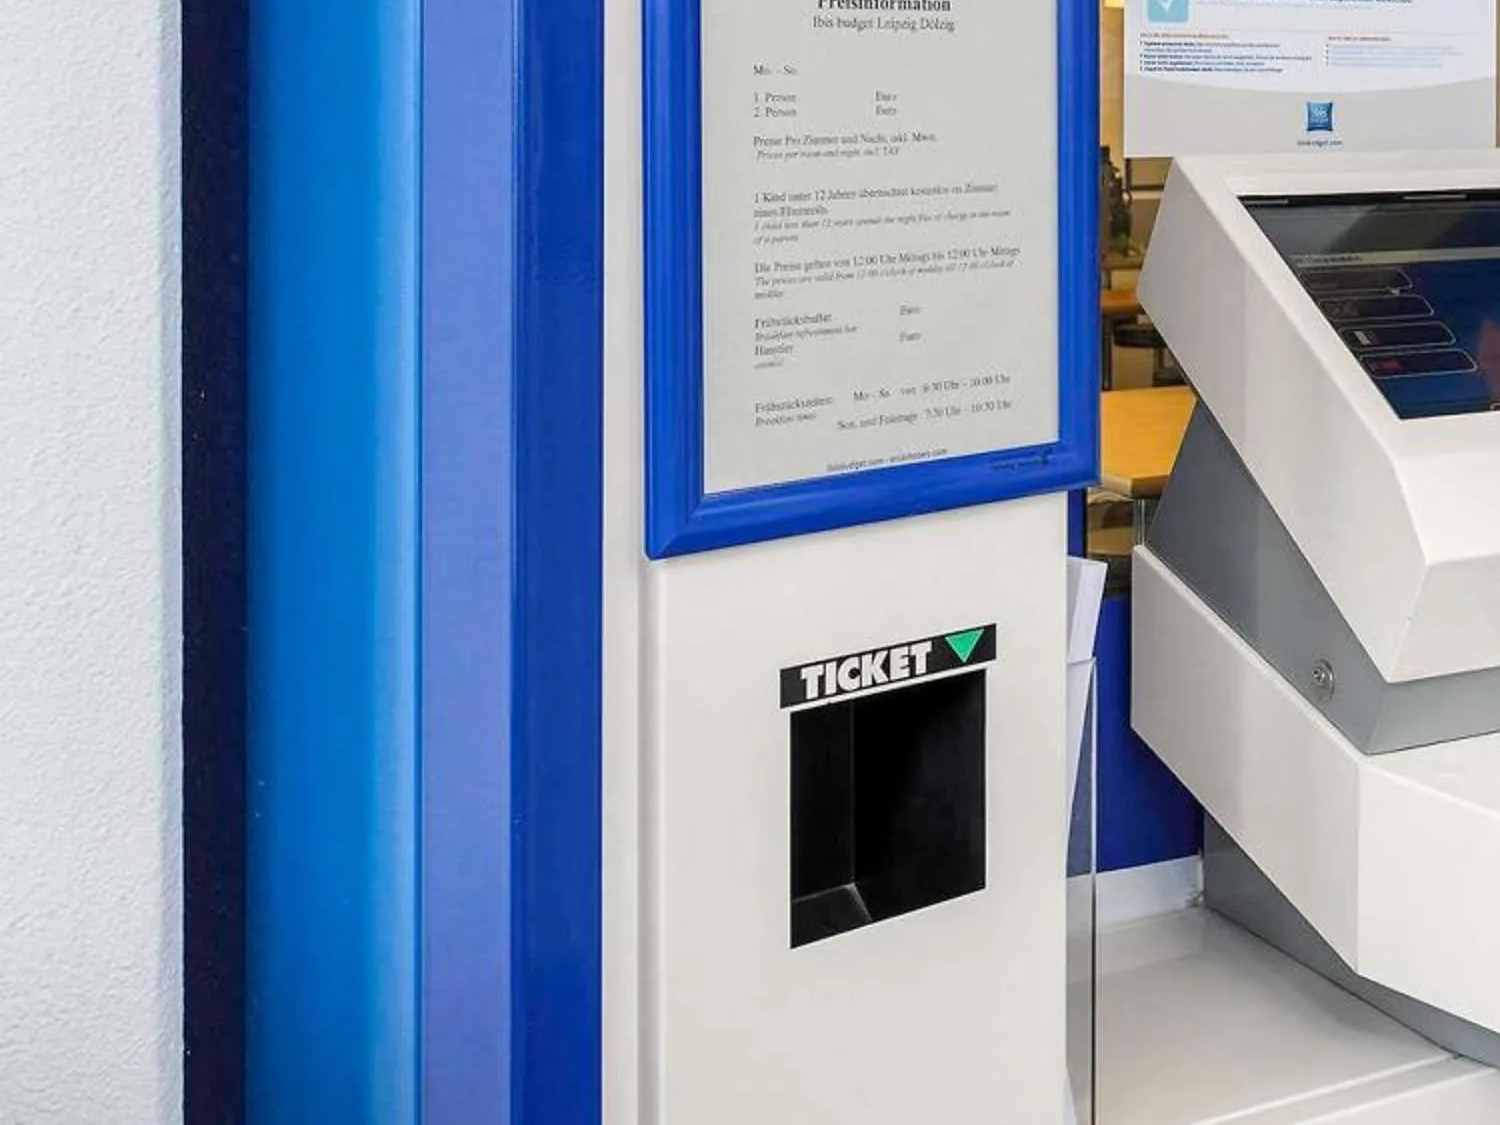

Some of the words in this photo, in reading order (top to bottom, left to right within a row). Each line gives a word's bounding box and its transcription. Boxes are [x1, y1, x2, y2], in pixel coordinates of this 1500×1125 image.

[812, 16, 834, 29] Ibis
[836, 16, 874, 32] budget
[877, 17, 917, 33] Leipzig
[800, 640, 933, 700] TICKET
